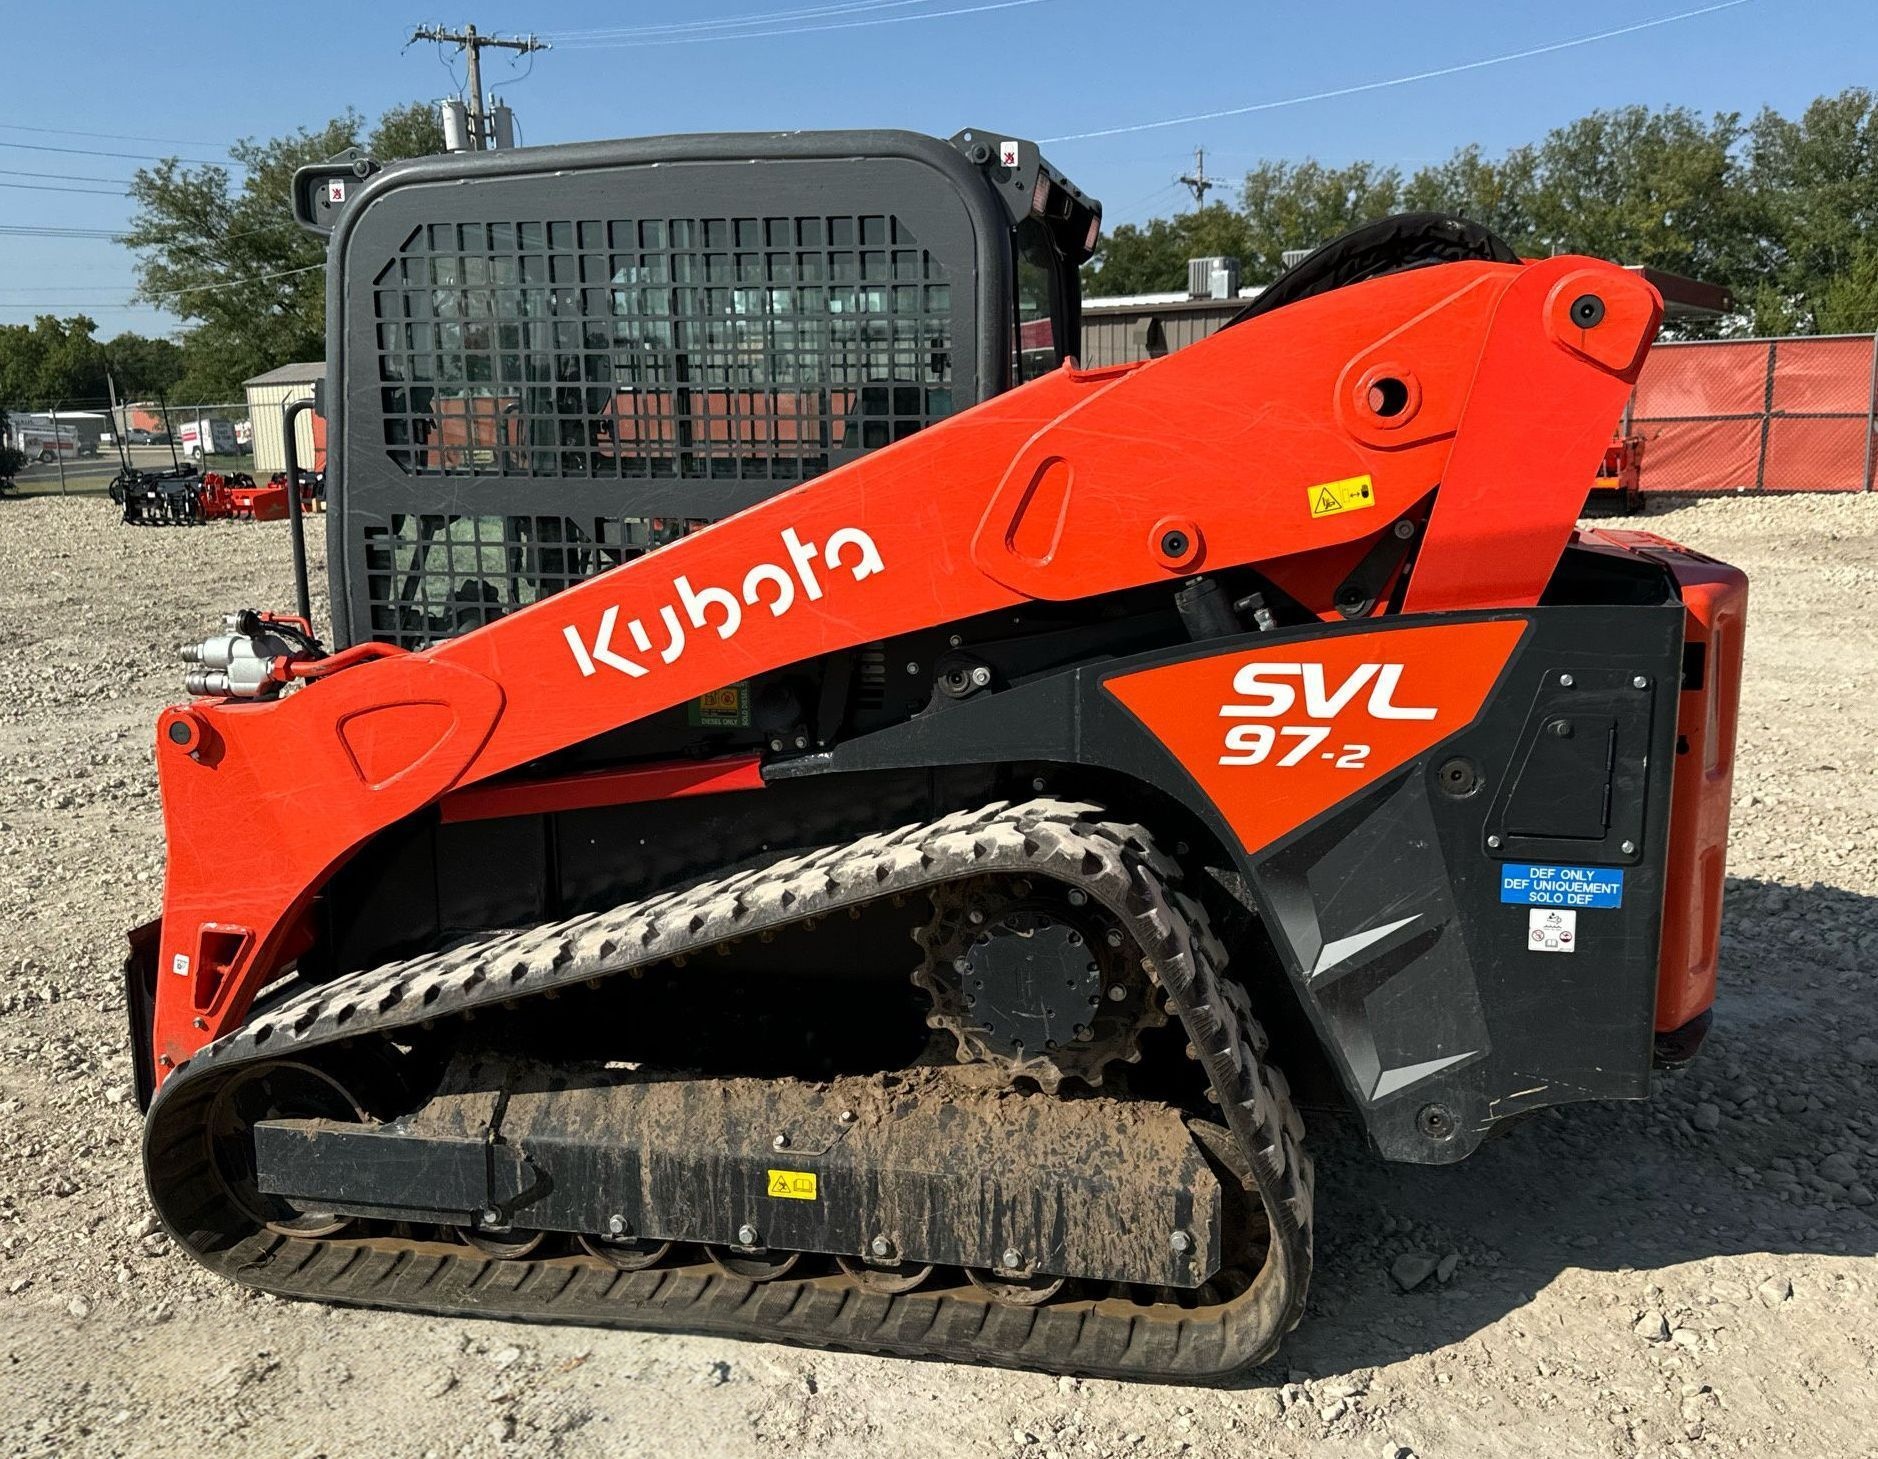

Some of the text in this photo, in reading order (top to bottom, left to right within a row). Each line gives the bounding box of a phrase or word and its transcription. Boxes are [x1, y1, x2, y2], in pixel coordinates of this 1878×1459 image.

[562, 527, 885, 678] Kubota
[1218, 662, 1438, 720] SVL
[1218, 724, 1371, 769] 97-2
[1504, 878, 1620, 894] DEF UNIQUEMENT
[1530, 868, 1595, 881] DEF ONLY
[1528, 892, 1594, 905] SOLO DEF
